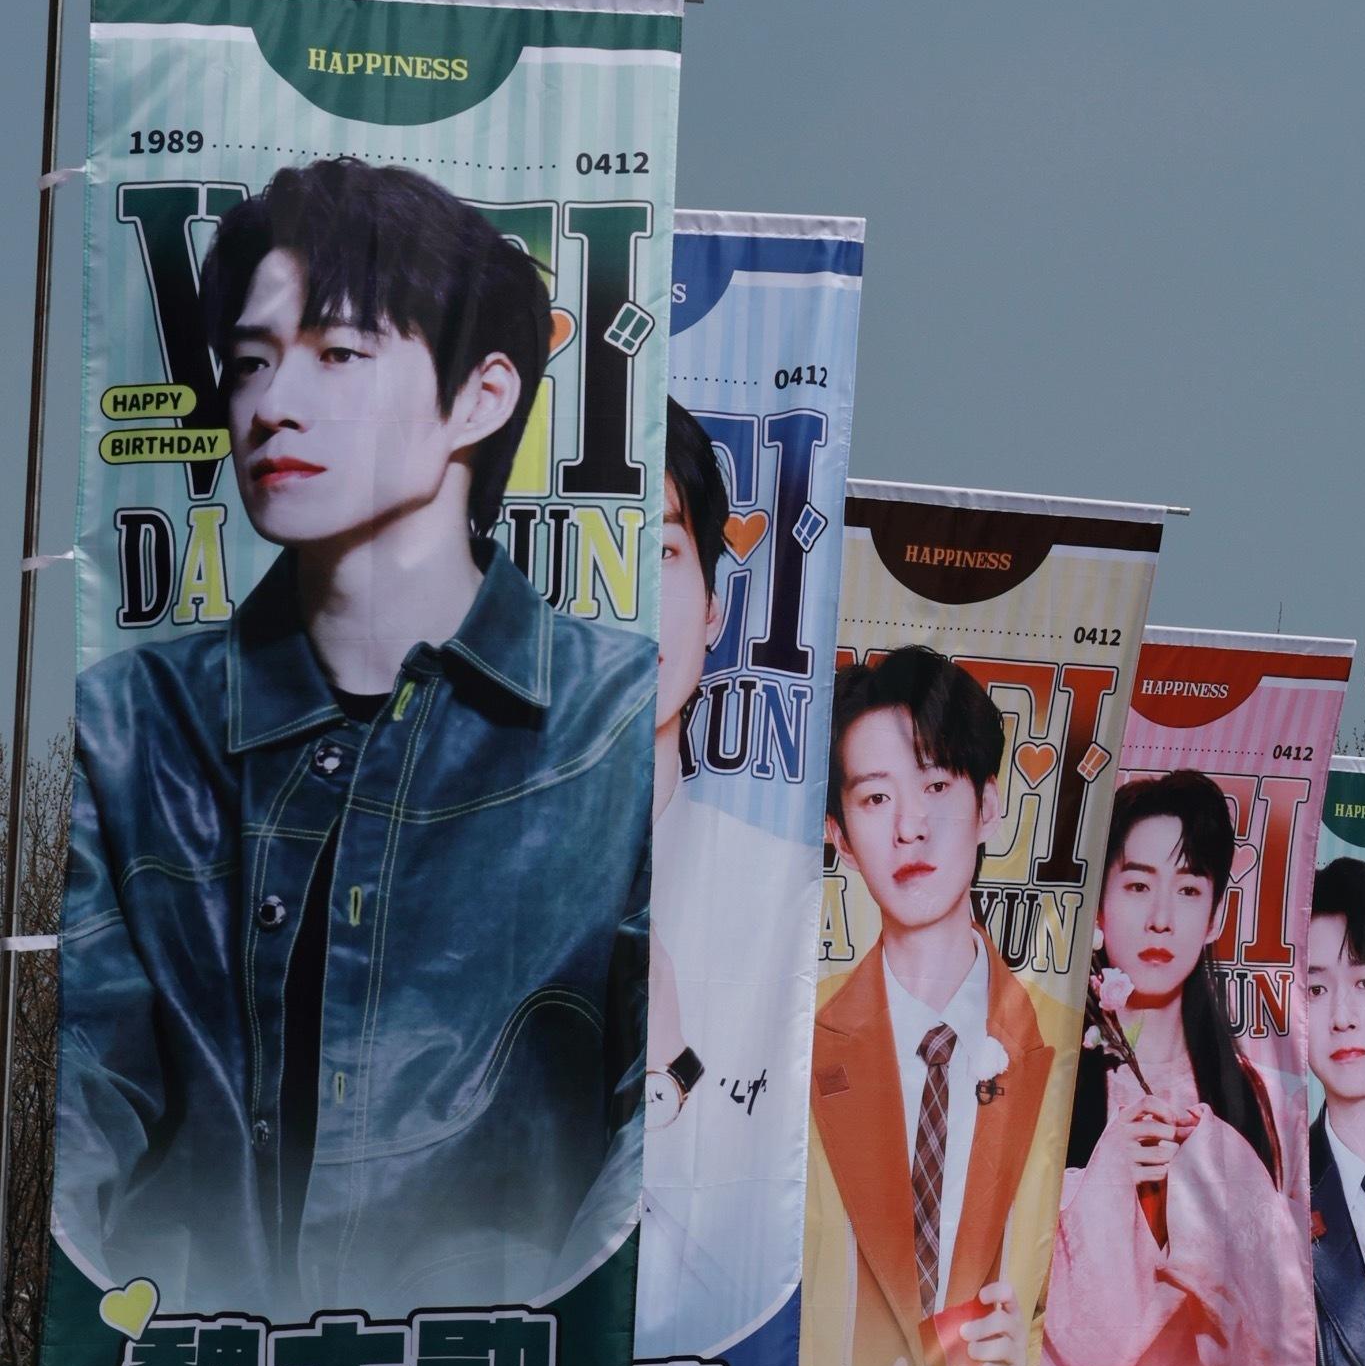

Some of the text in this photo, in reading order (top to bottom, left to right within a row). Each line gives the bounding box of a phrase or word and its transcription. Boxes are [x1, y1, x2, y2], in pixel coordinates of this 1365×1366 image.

[307, 47, 469, 82] HAPPINESS
[129, 129, 205, 157] 1989
[575, 151, 650, 176] 0412
[774, 366, 828, 390] 0412
[112, 391, 183, 413] HAPPY
[110, 435, 219, 458] BIRTHDAY
[115, 502, 648, 629] DAUN
[904, 544, 1012, 571] HAPPINESS
[1073, 626, 1121, 647] 0412
[1141, 679, 1229, 699] HAPPINESS
[1272, 744, 1314, 762] 0412
